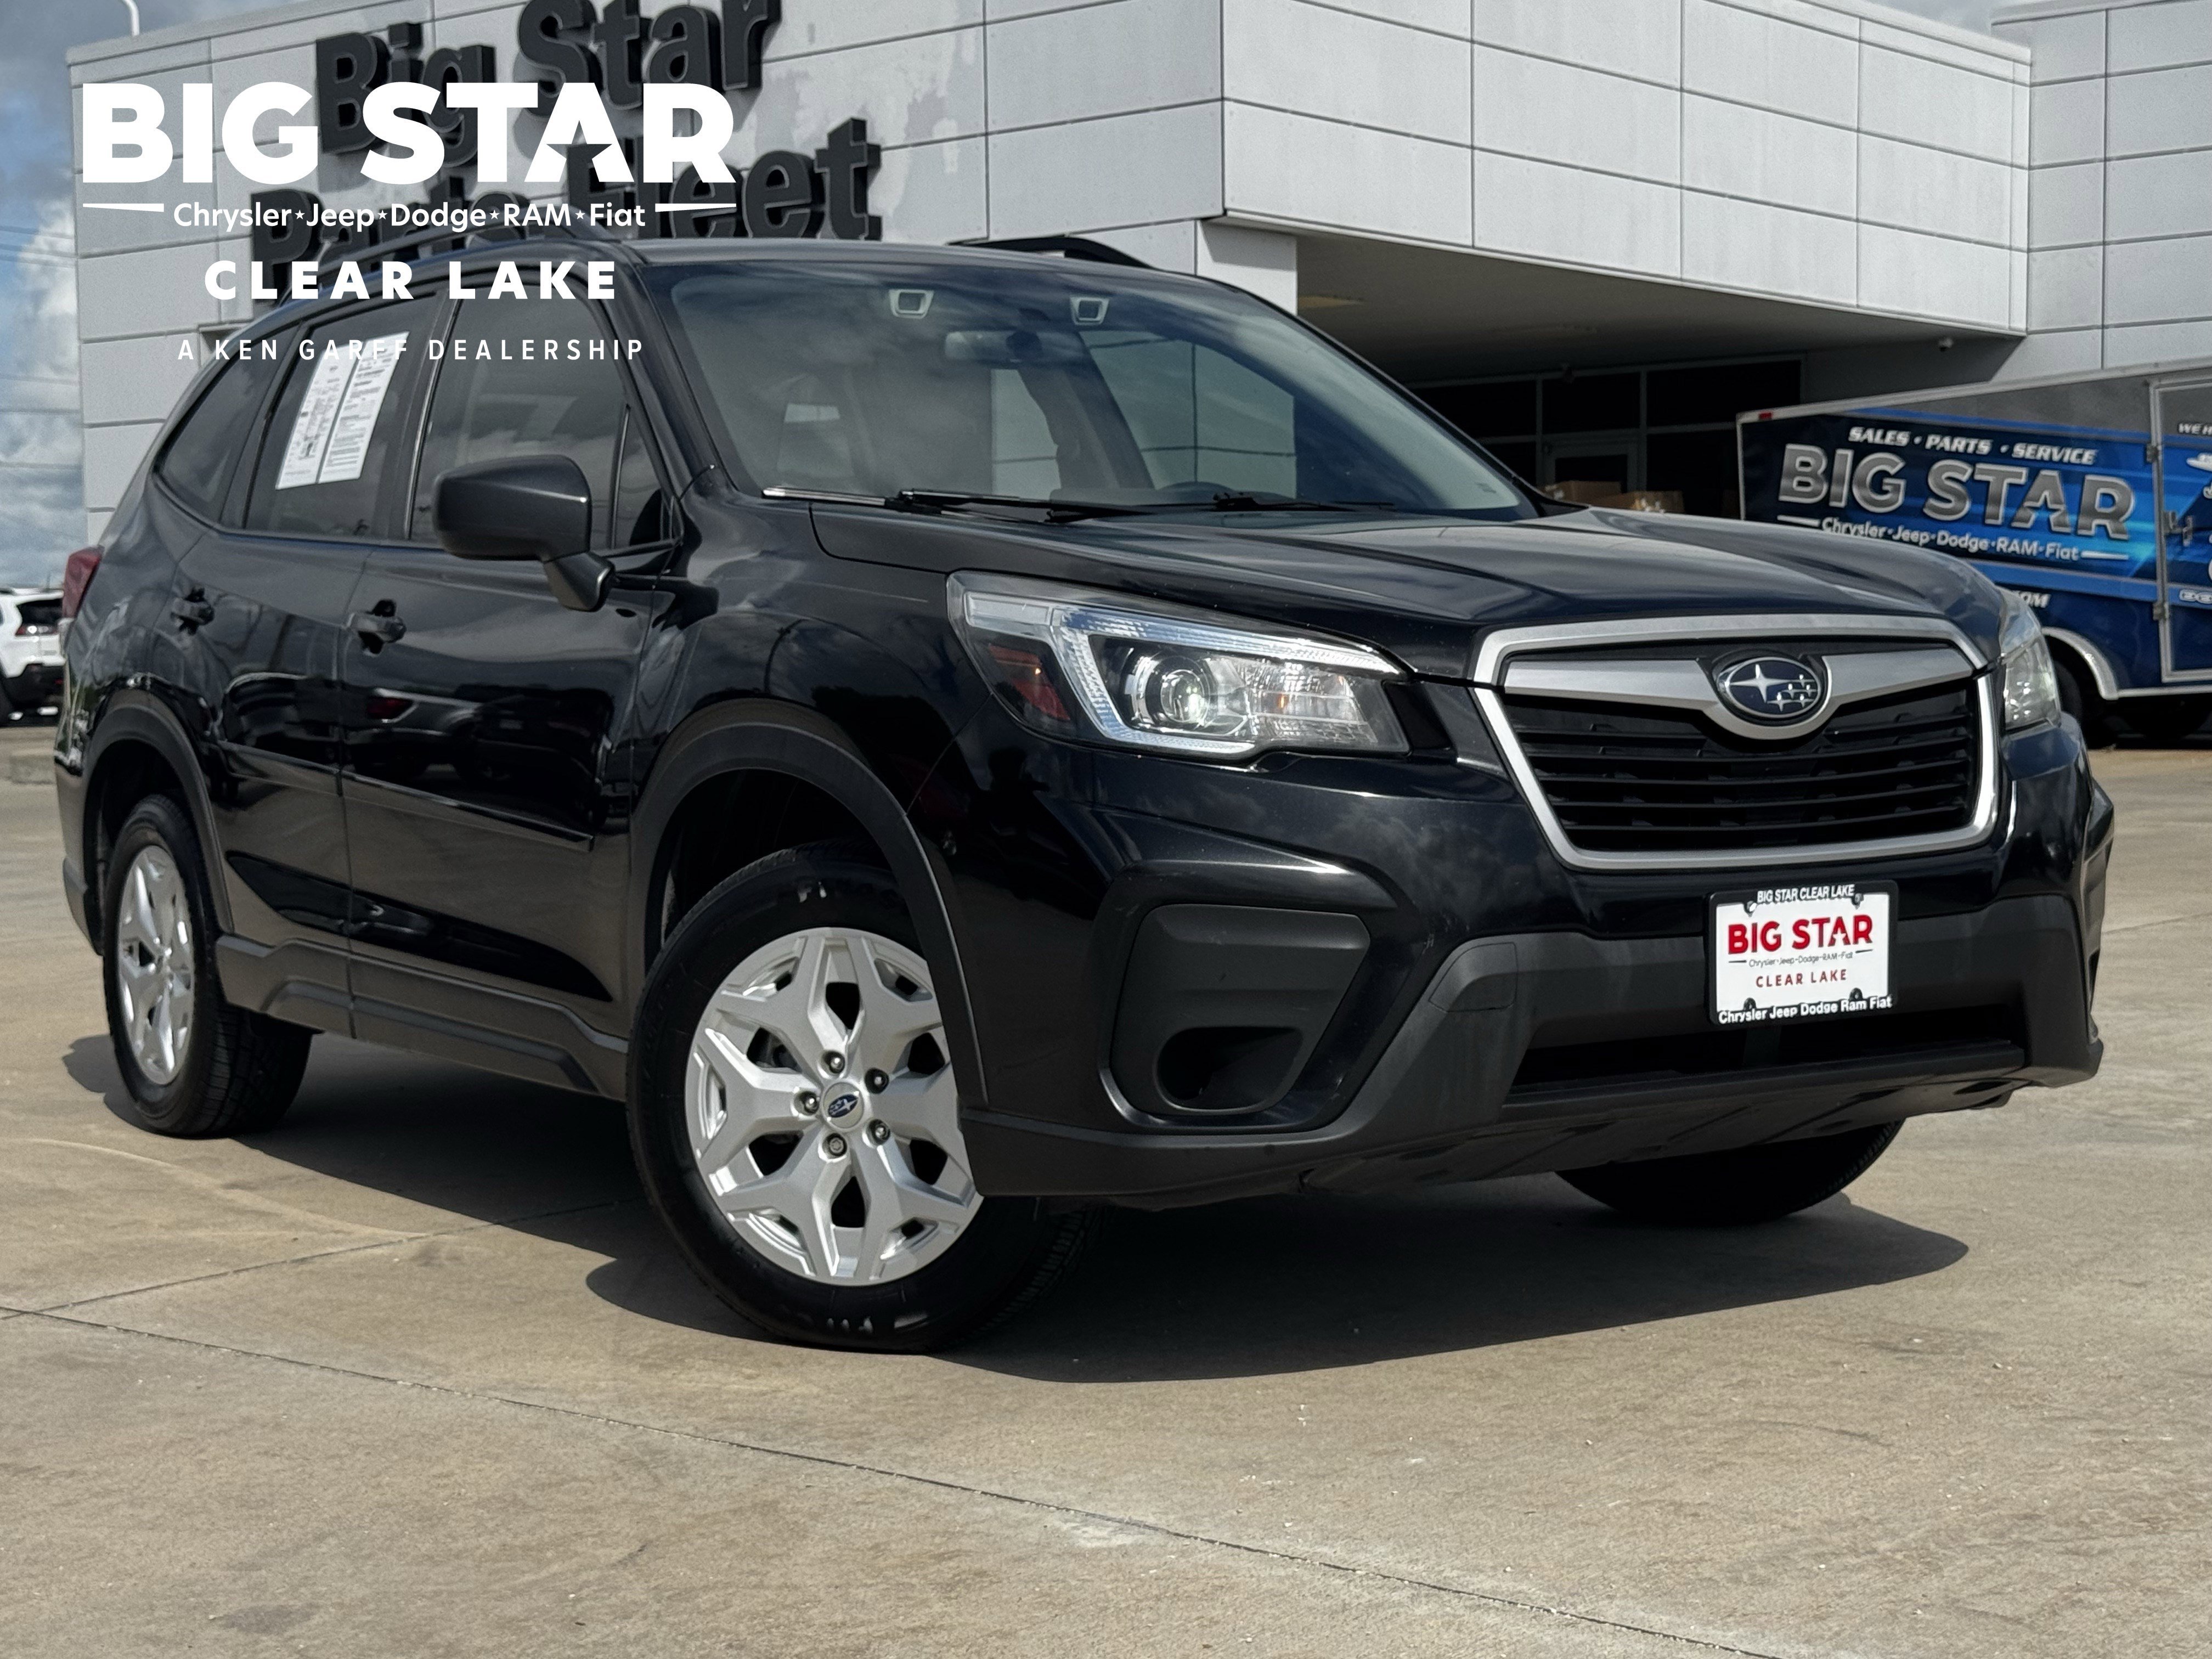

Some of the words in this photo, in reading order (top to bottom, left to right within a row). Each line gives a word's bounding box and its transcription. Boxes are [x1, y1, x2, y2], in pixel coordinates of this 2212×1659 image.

[517, 0, 781, 119] Star
[1848, 426, 1911, 447] SALES
[1925, 434, 1993, 455] PARTS
[2011, 442, 2097, 465] SERVICE
[1779, 443, 1906, 513] BIG
[1922, 459, 2135, 540] STAR
[1821, 517, 1887, 538] Chrysler
[1893, 525, 1930, 546] Jeep
[1937, 529, 1990, 552] Dodge
[1996, 537, 2039, 556] RAM
[2046, 541, 2080, 561] Fiat
[1757, 889, 1774, 904] BIG
[1775, 888, 1798, 903] STAR
[1799, 885, 1830, 900] CLEAR
[1831, 884, 1855, 898] LAKE
[1728, 921, 1782, 955] BIG
[1791, 915, 1873, 950] STAR
[1756, 973, 1803, 988] CLEAR
[1811, 969, 1847, 983] LAKE
[1718, 1008, 1768, 1024] Chrysler
[1769, 1006, 1798, 1019] Jeep
[1801, 1002, 1838, 1016] Dodge
[1841, 999, 1867, 1012] Ram
[1869, 996, 1893, 1010] Fiat
